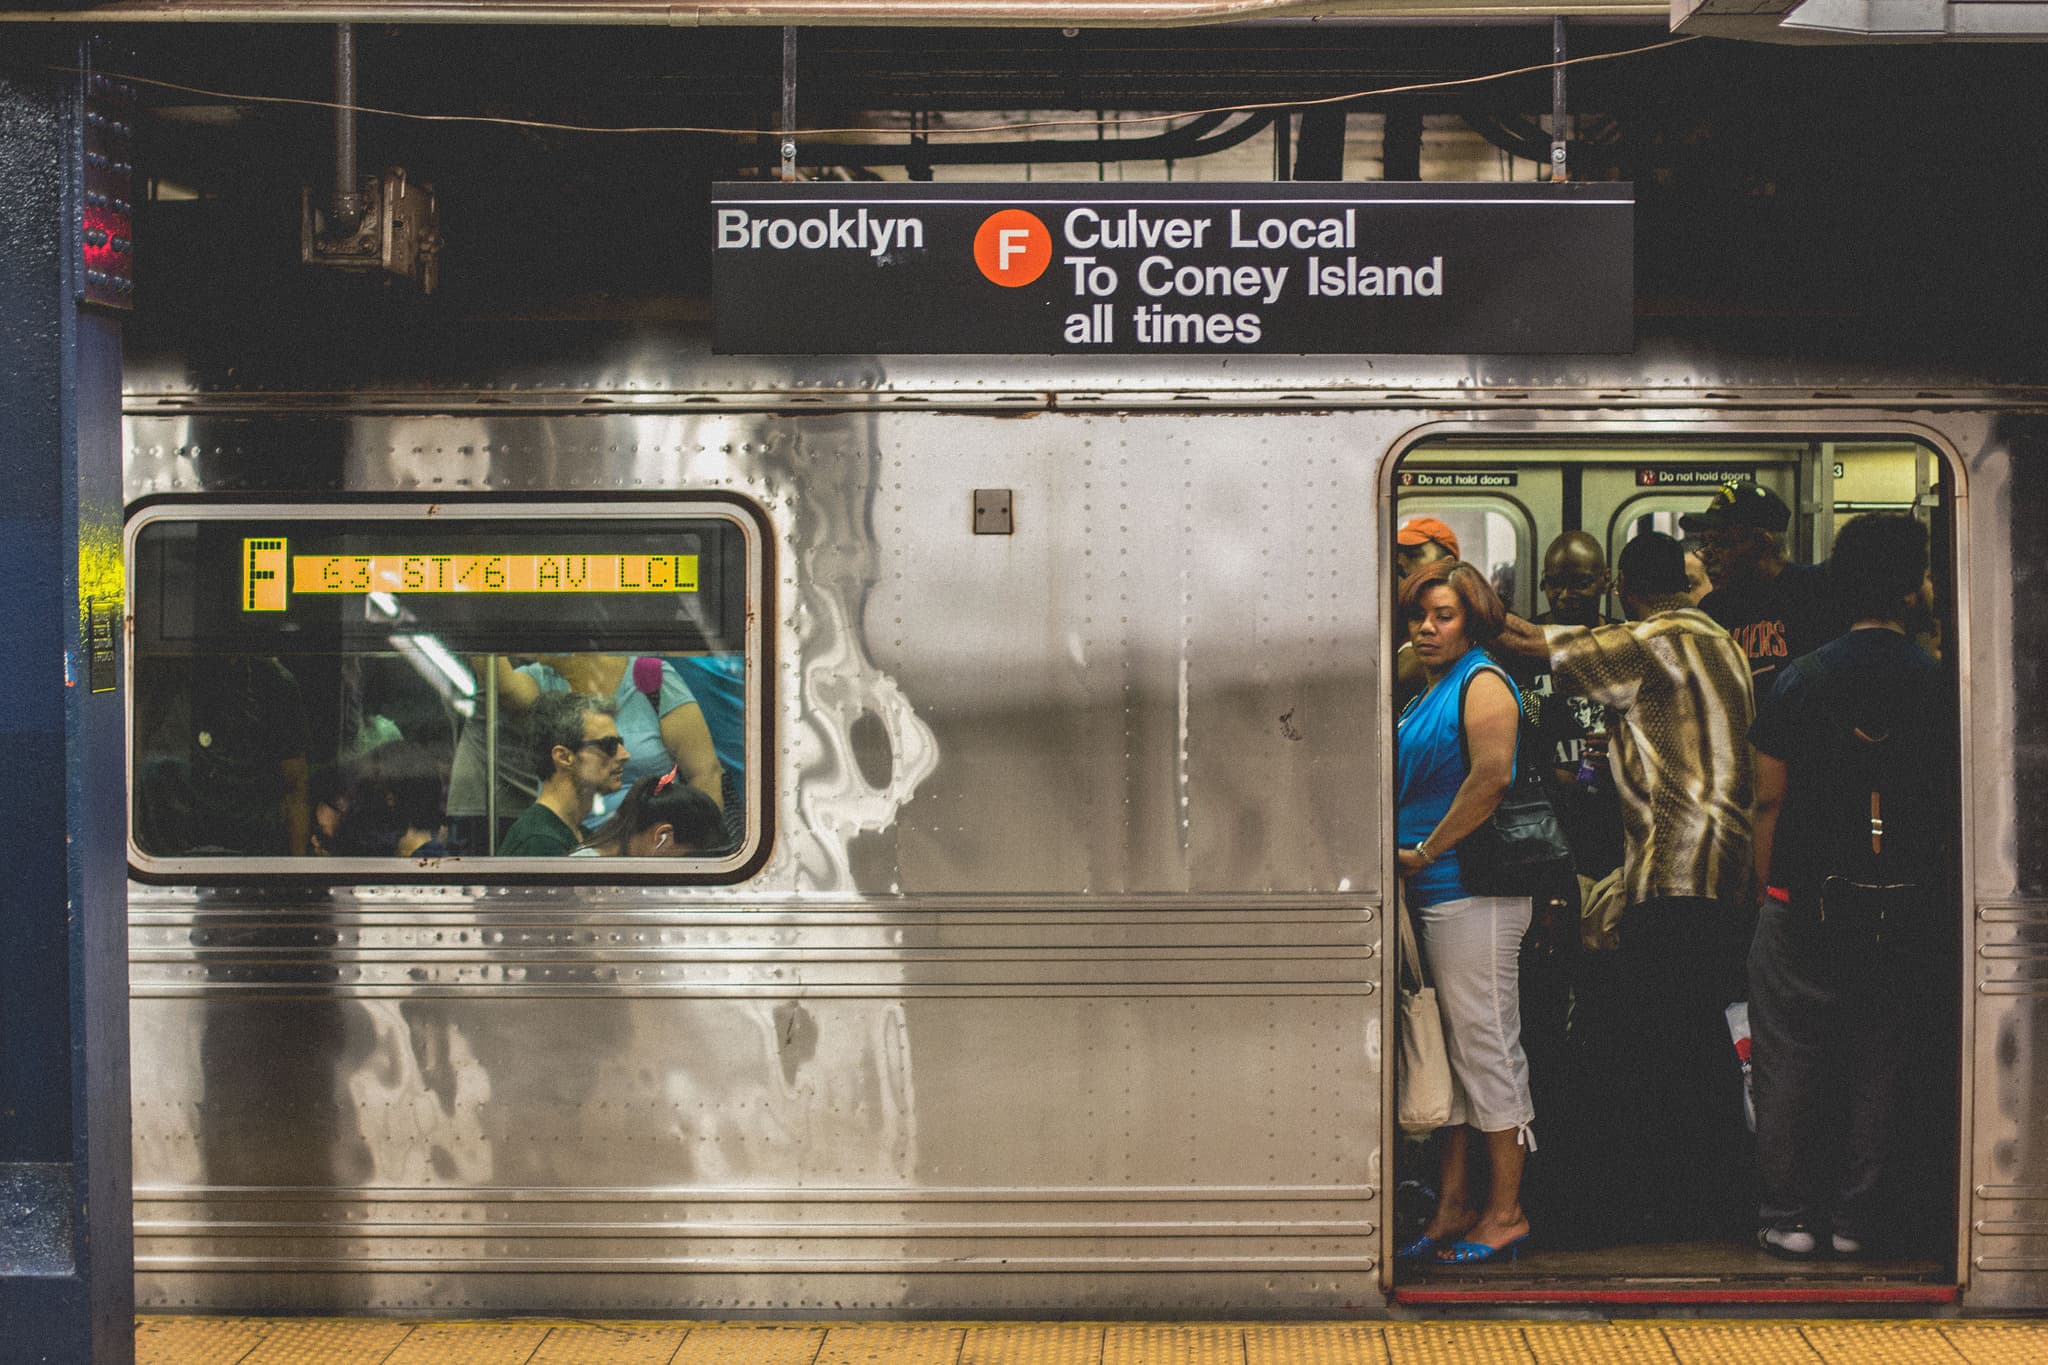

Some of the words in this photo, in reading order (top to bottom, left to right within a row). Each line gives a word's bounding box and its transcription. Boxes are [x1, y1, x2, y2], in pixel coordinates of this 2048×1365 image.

[717, 208, 924, 257] Brooklyn
[1063, 208, 1211, 249] Culver
[1230, 208, 1356, 249] Local
[999, 229, 1030, 271] F
[1063, 255, 1118, 297] To
[1137, 255, 1289, 304] Coney
[1308, 256, 1443, 297] Island
[1063, 303, 1113, 344] all
[1133, 303, 1262, 344] times
[1417, 474, 1433, 485] Do
[1435, 474, 1452, 485] not
[1455, 474, 1478, 485] hold
[1480, 474, 1510, 485] doors
[1659, 471, 1674, 482] Do
[1676, 471, 1693, 481] not
[1695, 471, 1719, 481] hold
[1720, 471, 1751, 481] doors
[249, 541, 282, 609] F
[404, 557, 505, 588] ST/6
[539, 557, 586, 588] AV
[620, 557, 695, 588] LCL
